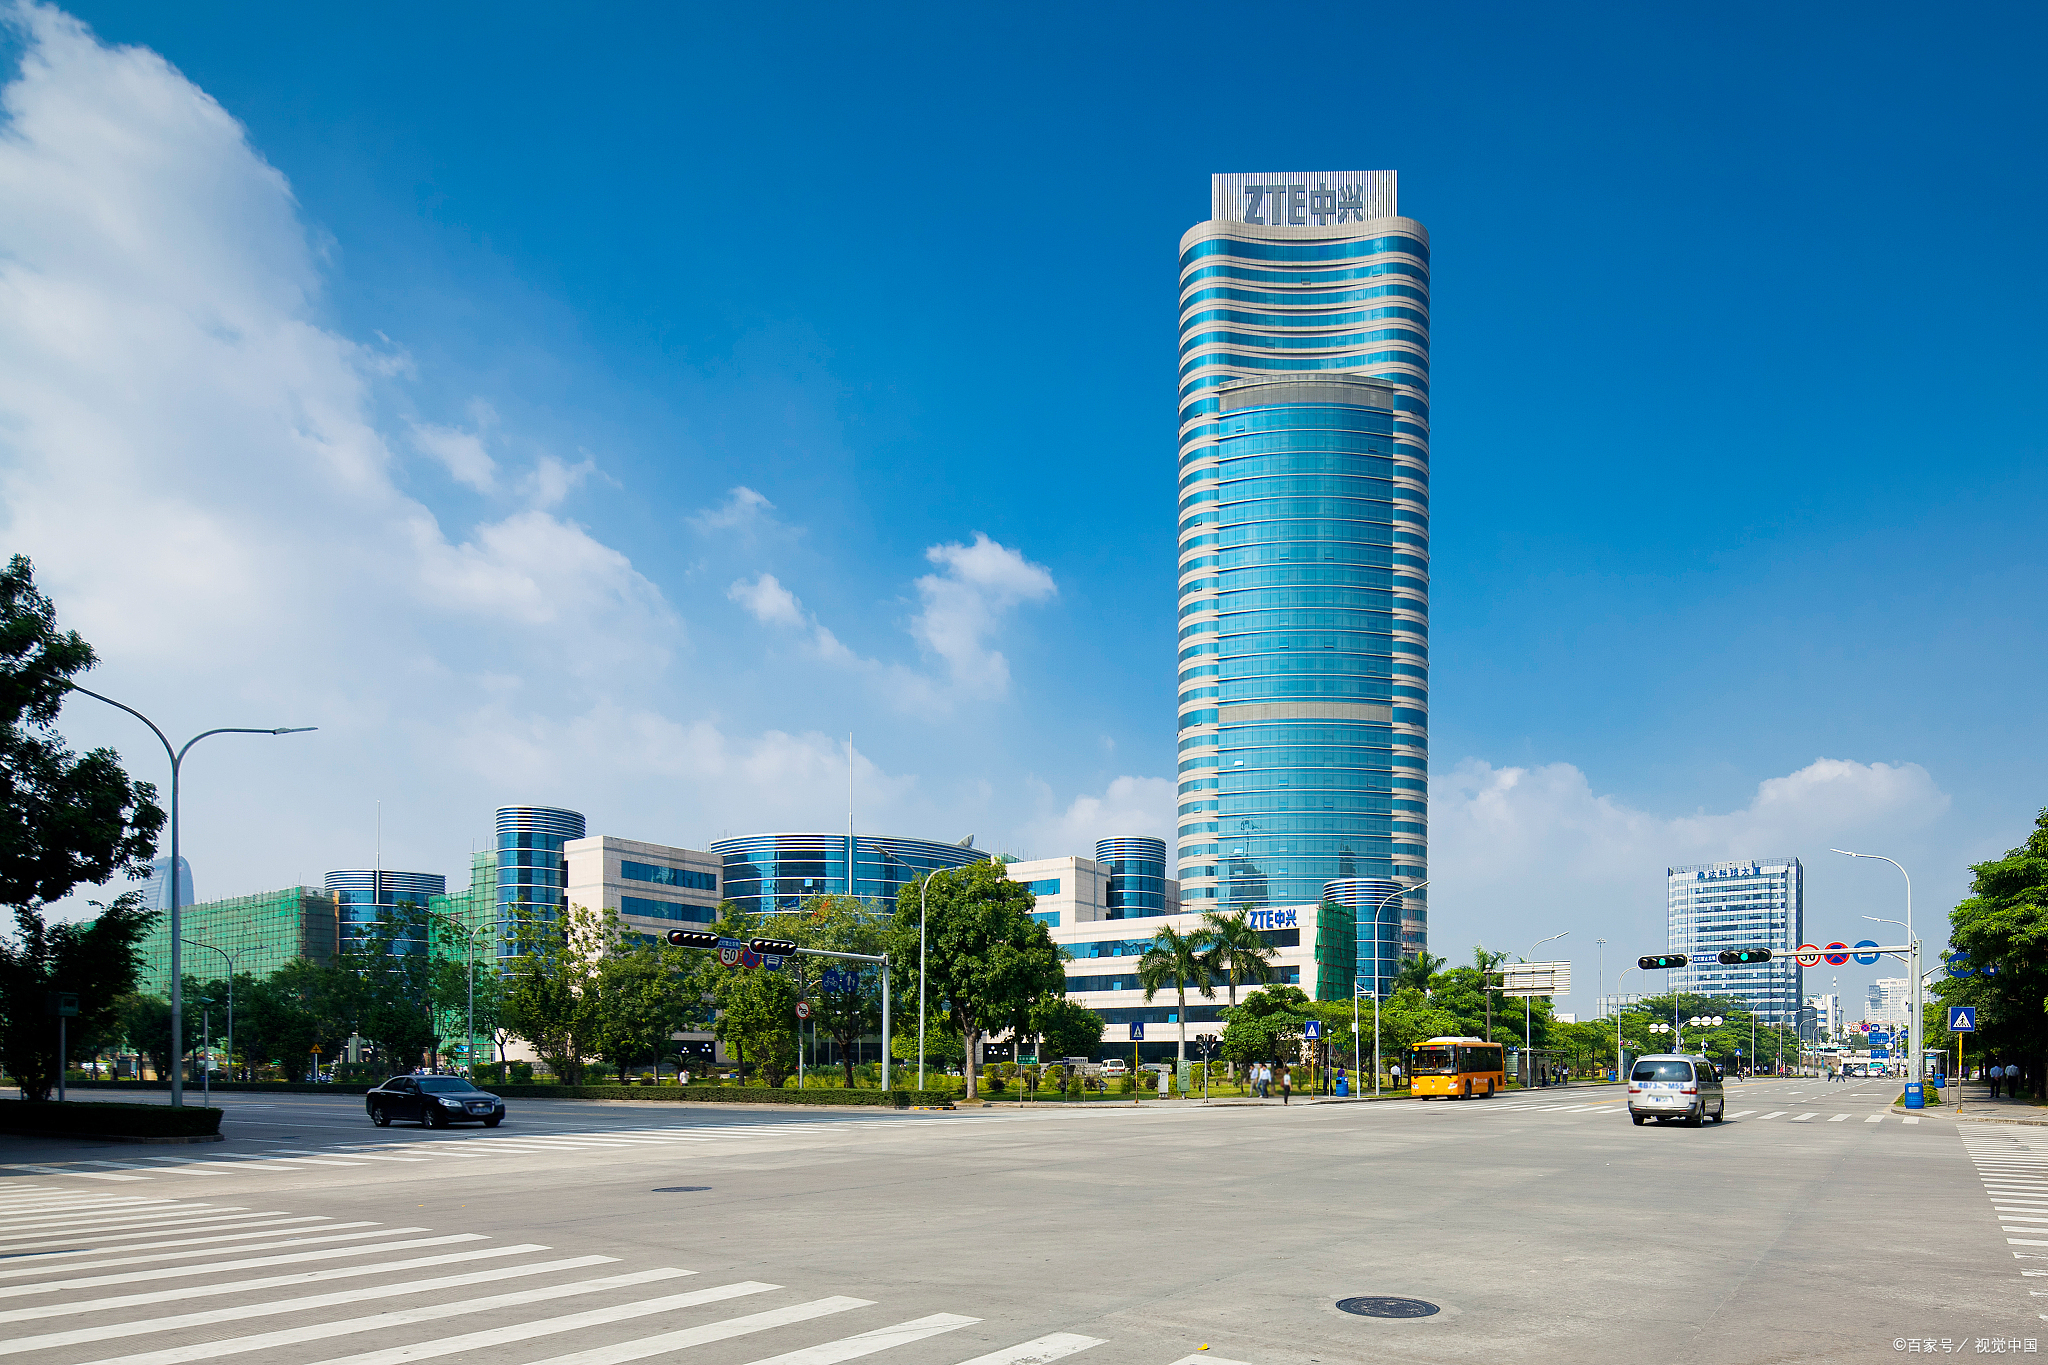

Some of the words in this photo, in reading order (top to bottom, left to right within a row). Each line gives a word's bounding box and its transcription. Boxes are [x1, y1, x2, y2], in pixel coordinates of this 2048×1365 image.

[1245, 183, 1363, 225] ZTE中兴
[1250, 909, 1297, 929] ZTE中兴
[724, 949, 736, 961] 50
